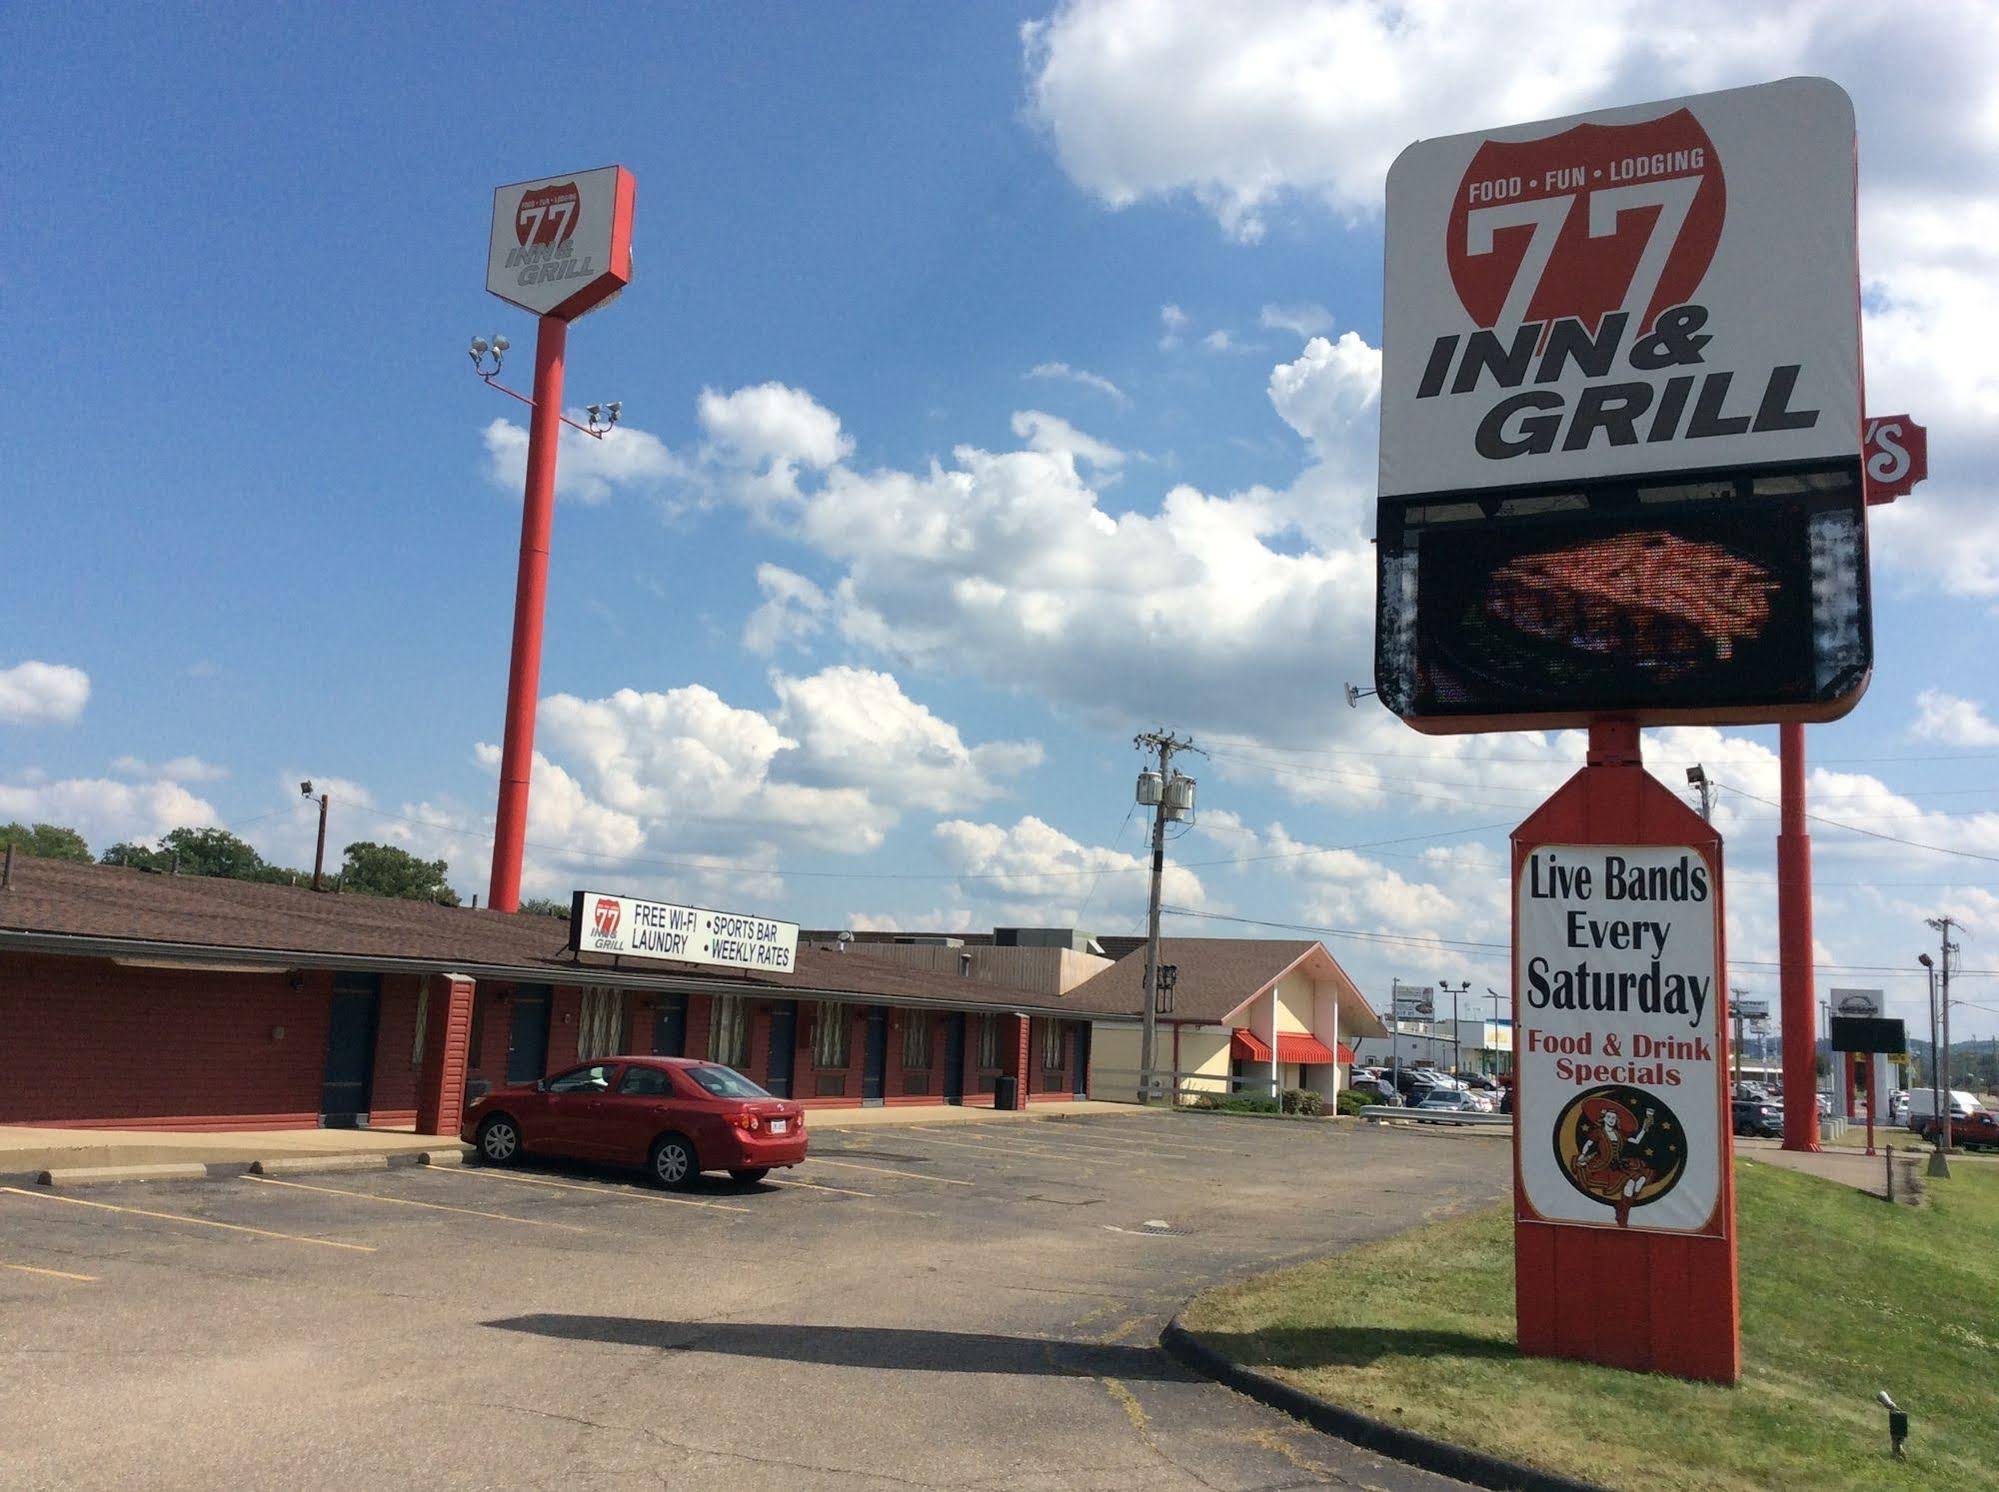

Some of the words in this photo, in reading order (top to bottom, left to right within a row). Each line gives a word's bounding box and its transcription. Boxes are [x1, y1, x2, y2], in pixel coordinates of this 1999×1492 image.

[1468, 177, 1522, 204] FOOD
[1545, 166, 1586, 191] FUN
[1609, 147, 1704, 181] LODGING
[520, 200, 576, 250] 77
[517, 256, 594, 287] GRILL
[1466, 174, 1704, 340] 77
[1474, 364, 1821, 460] GRILL
[1531, 854, 1592, 900] Live
[1605, 856, 1708, 902] Bands
[596, 908, 620, 935] 77
[634, 904, 666, 928] FREE
[712, 916, 755, 940] SPORTS
[757, 924, 778, 943] BAR
[594, 938, 624, 951] GRILL
[632, 928, 688, 955] LAUNDRY
[1567, 910, 1671, 960] Every
[712, 938, 755, 962] WEEKLY
[757, 945, 790, 967] RATES
[1527, 956, 1711, 1028] Saturday
[1528, 1029, 1592, 1055] Food
[1602, 1033, 1622, 1057] &
[1633, 1034, 1712, 1061] Drink
[1556, 1058, 1682, 1086] Specials
